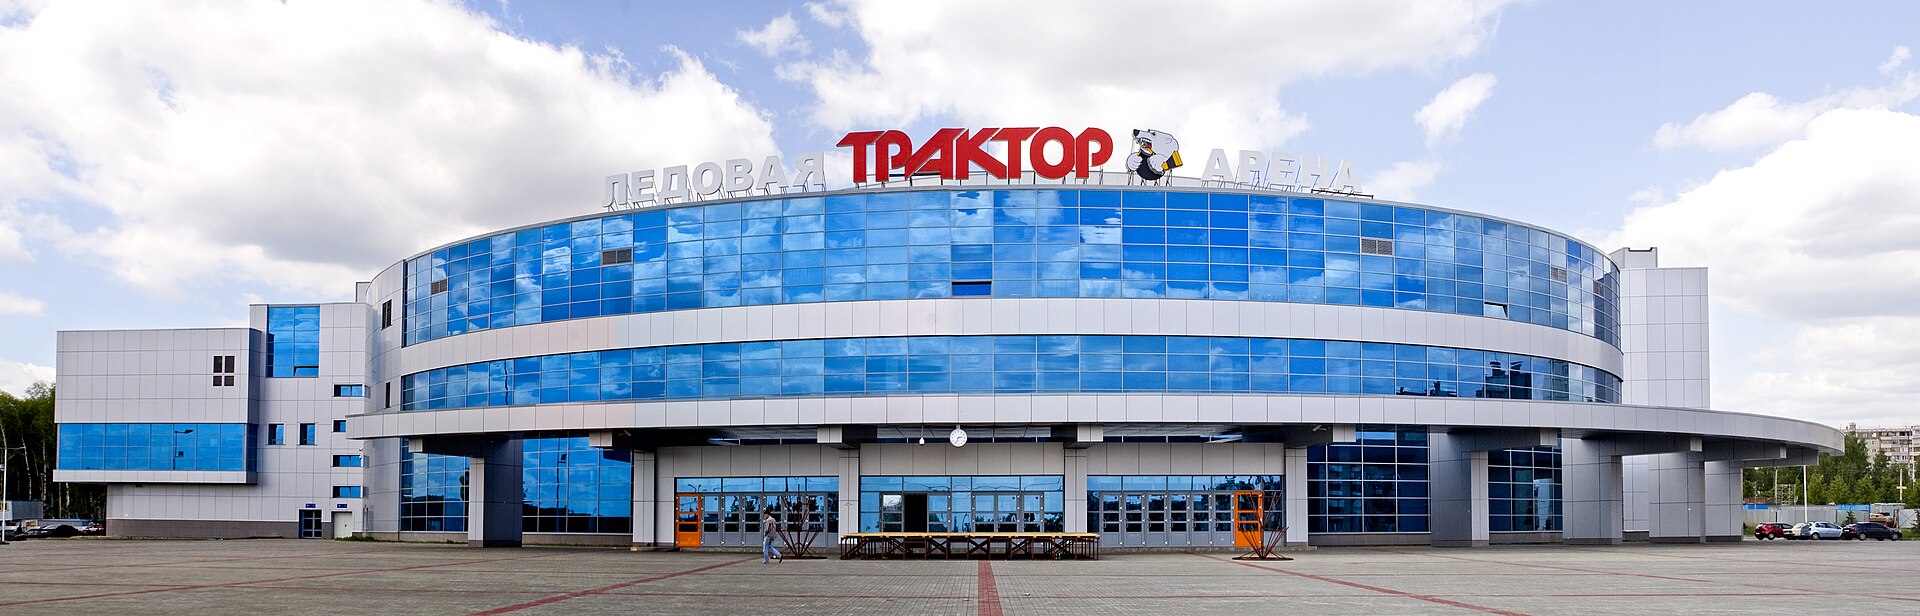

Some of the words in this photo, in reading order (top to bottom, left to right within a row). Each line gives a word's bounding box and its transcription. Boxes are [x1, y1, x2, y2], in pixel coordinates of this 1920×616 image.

[602, 152, 825, 207] ЛЕДОВАЯ
[836, 126, 1113, 183] ТРАКТОР
[1202, 148, 1362, 193] АРЕНА
